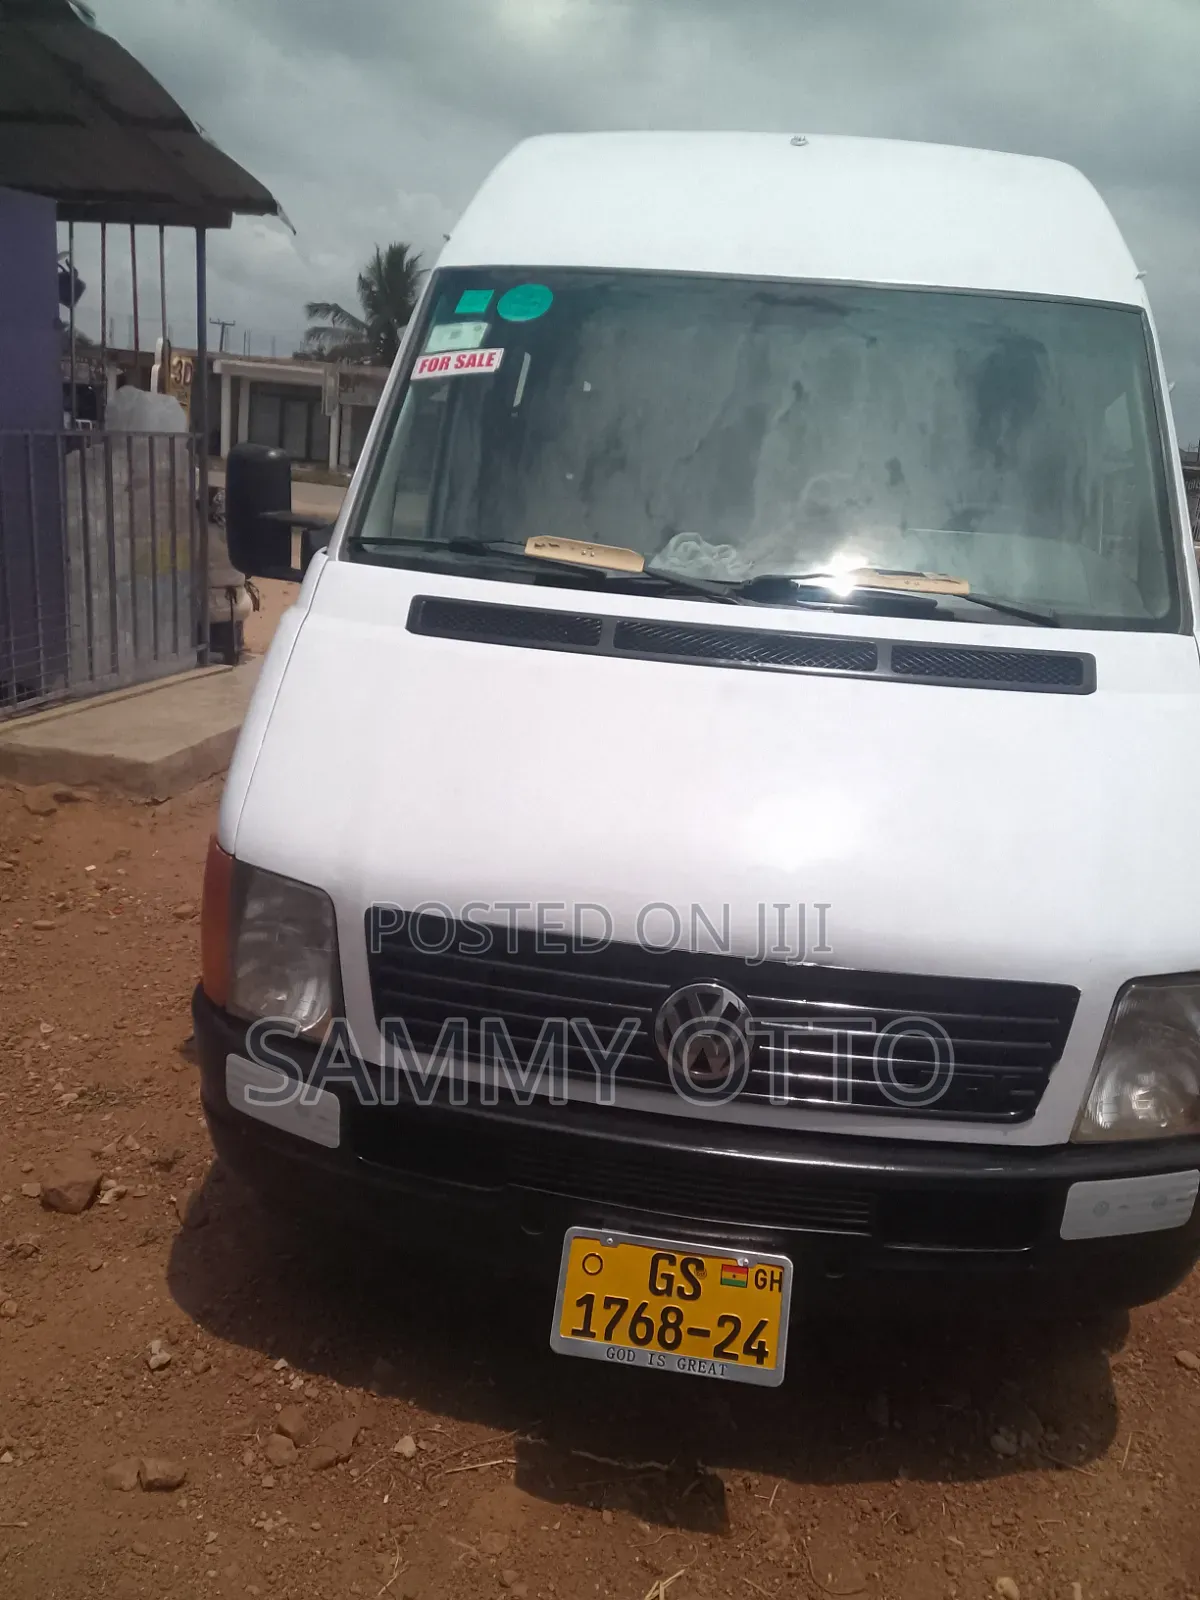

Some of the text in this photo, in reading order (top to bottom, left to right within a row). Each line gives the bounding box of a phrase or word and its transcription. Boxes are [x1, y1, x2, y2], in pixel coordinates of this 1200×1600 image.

[418, 352, 496, 374] FOR SALE
[649, 1251, 705, 1301] GS
[754, 1268, 783, 1293] GH
[571, 1293, 769, 1365] 1768-24
[606, 1347, 728, 1377] GOD IS GREAT
